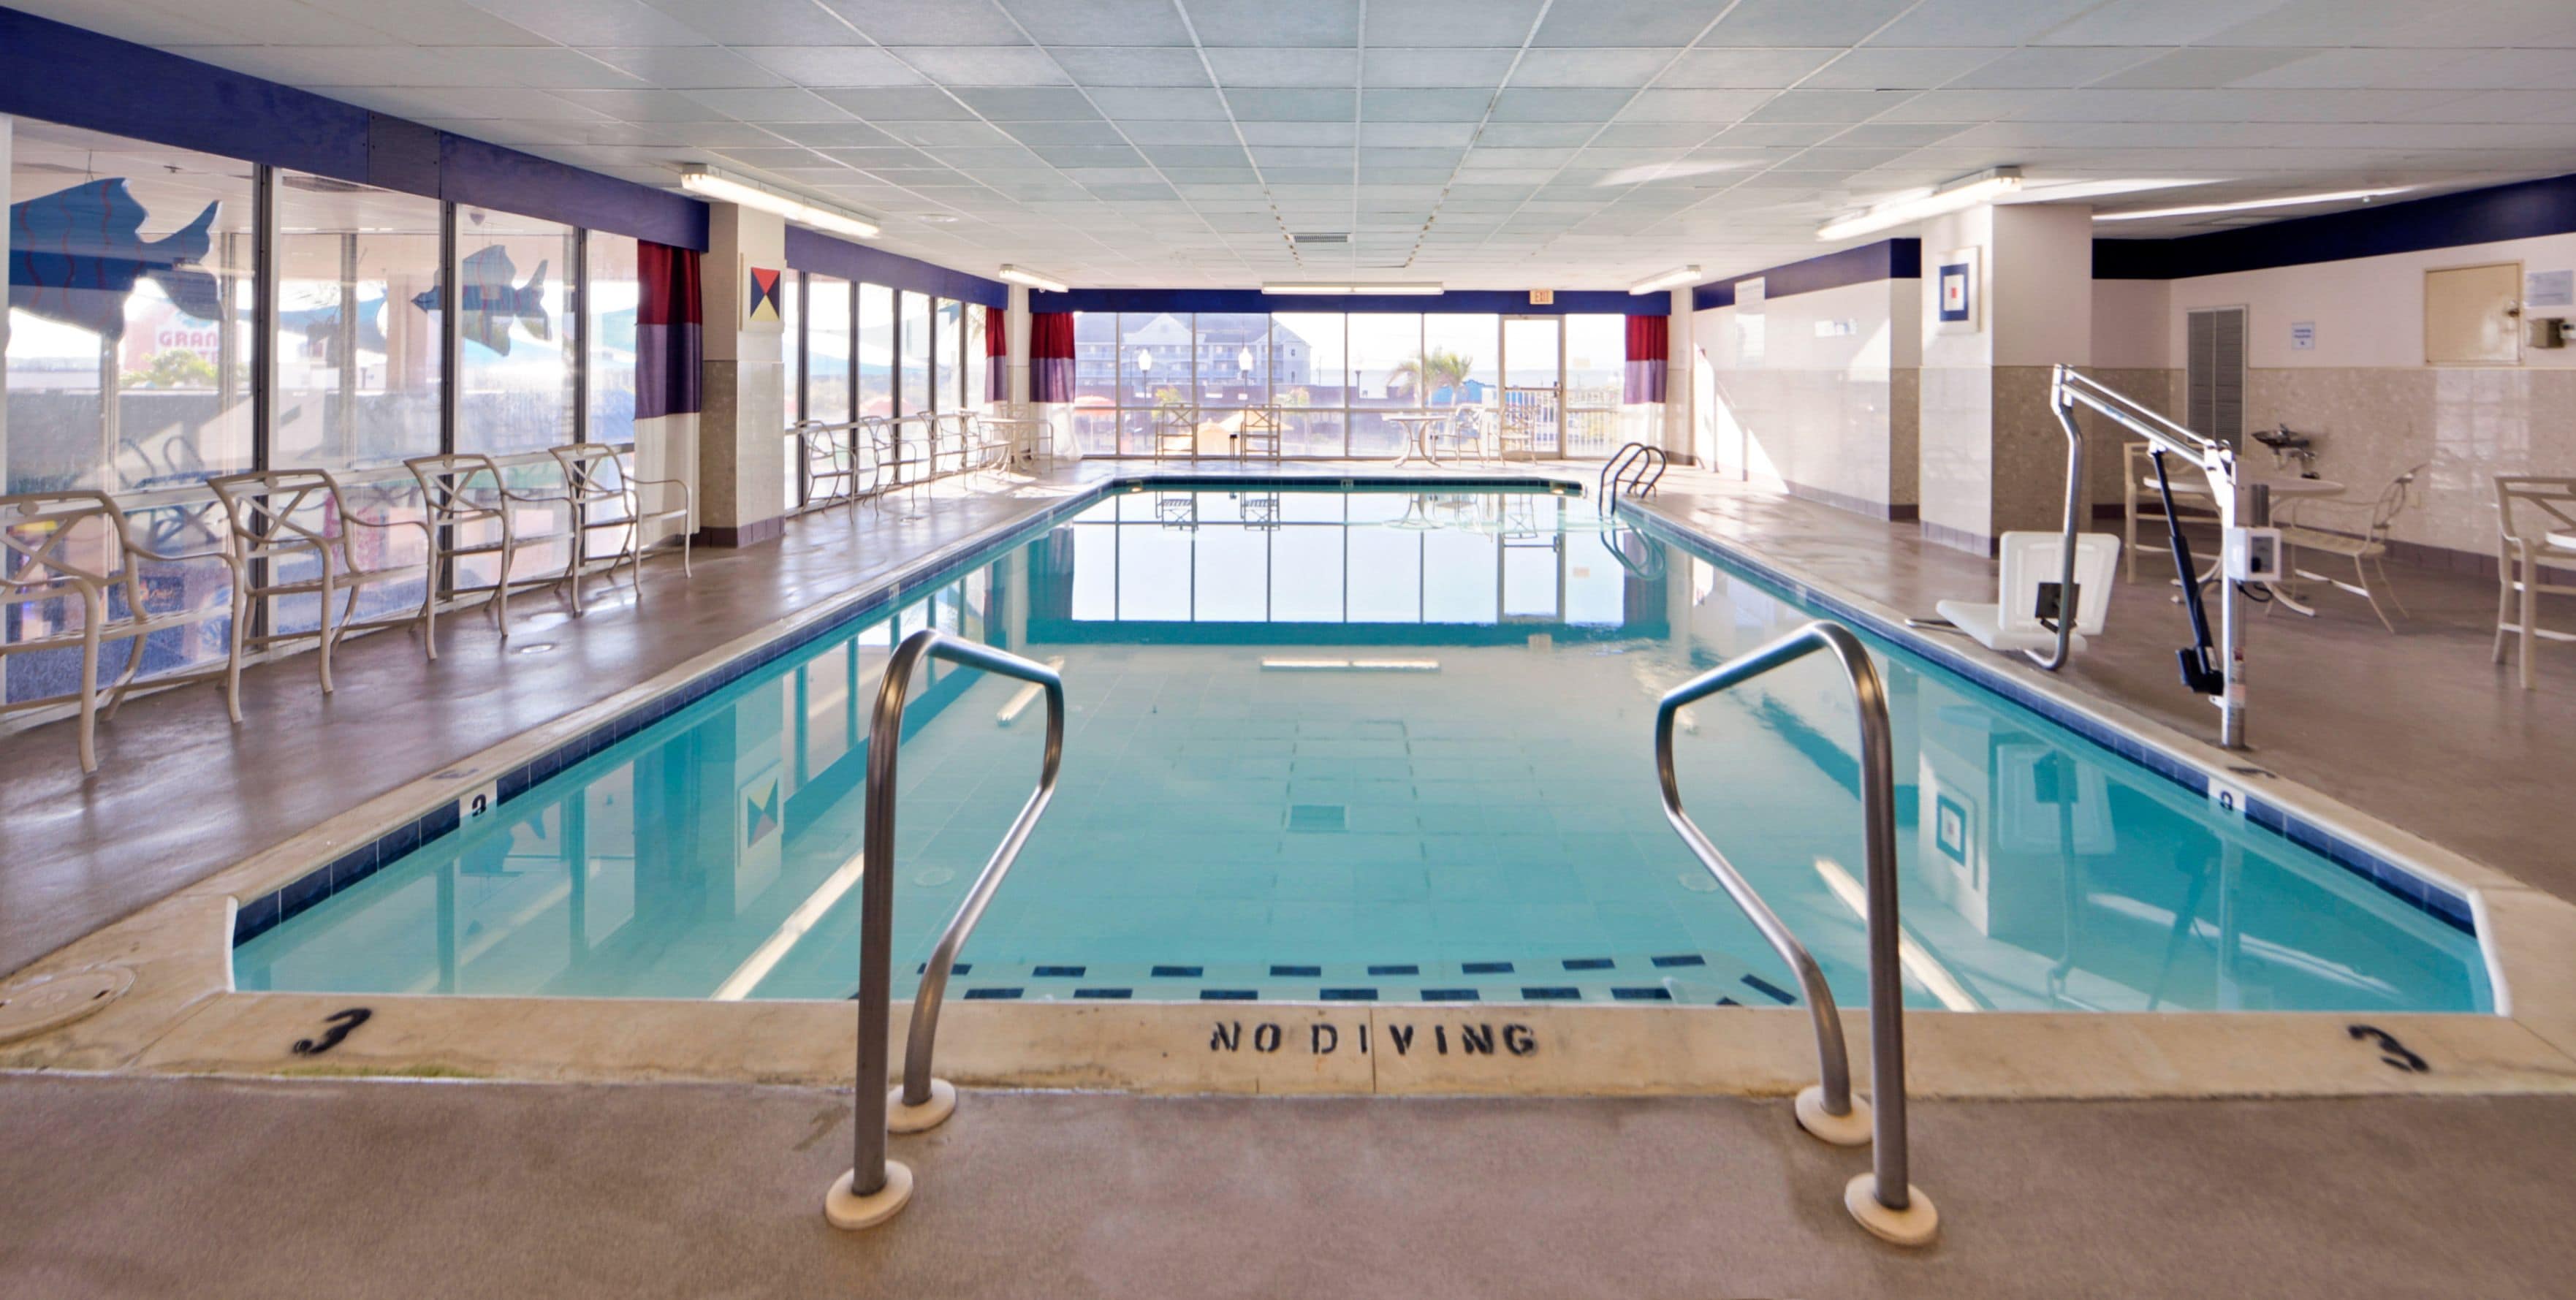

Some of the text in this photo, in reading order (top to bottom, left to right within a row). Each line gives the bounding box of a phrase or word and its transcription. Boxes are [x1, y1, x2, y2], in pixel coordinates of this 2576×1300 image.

[292, 1007, 371, 1054] 3
[1210, 1021, 1538, 1055] NO DIVING
[2348, 1024, 2430, 1073] 3
